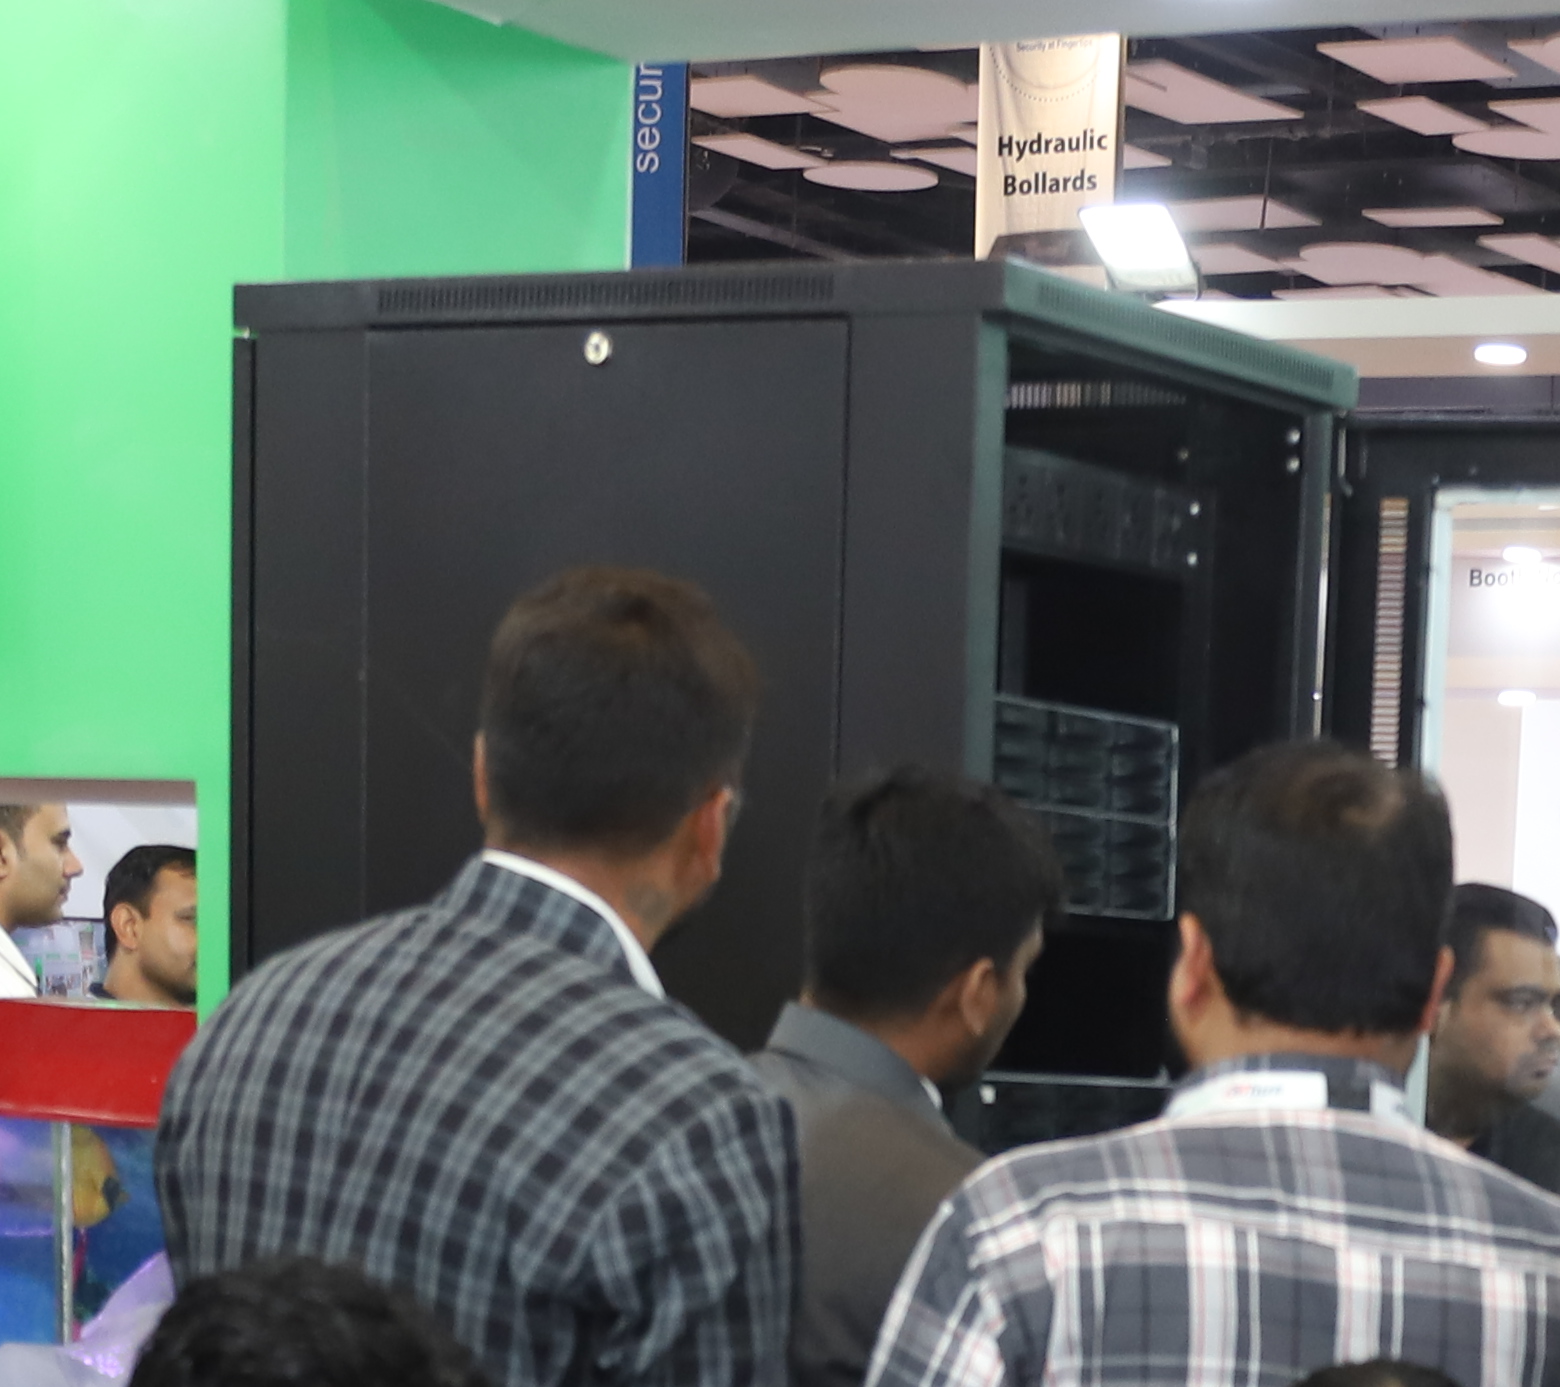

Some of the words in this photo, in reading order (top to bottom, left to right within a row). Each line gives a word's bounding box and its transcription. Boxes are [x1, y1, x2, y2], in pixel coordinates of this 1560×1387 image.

[998, 129, 1108, 162] Hydraulic
[1004, 168, 1097, 197] Bollards
[1469, 568, 1521, 587] Boot
